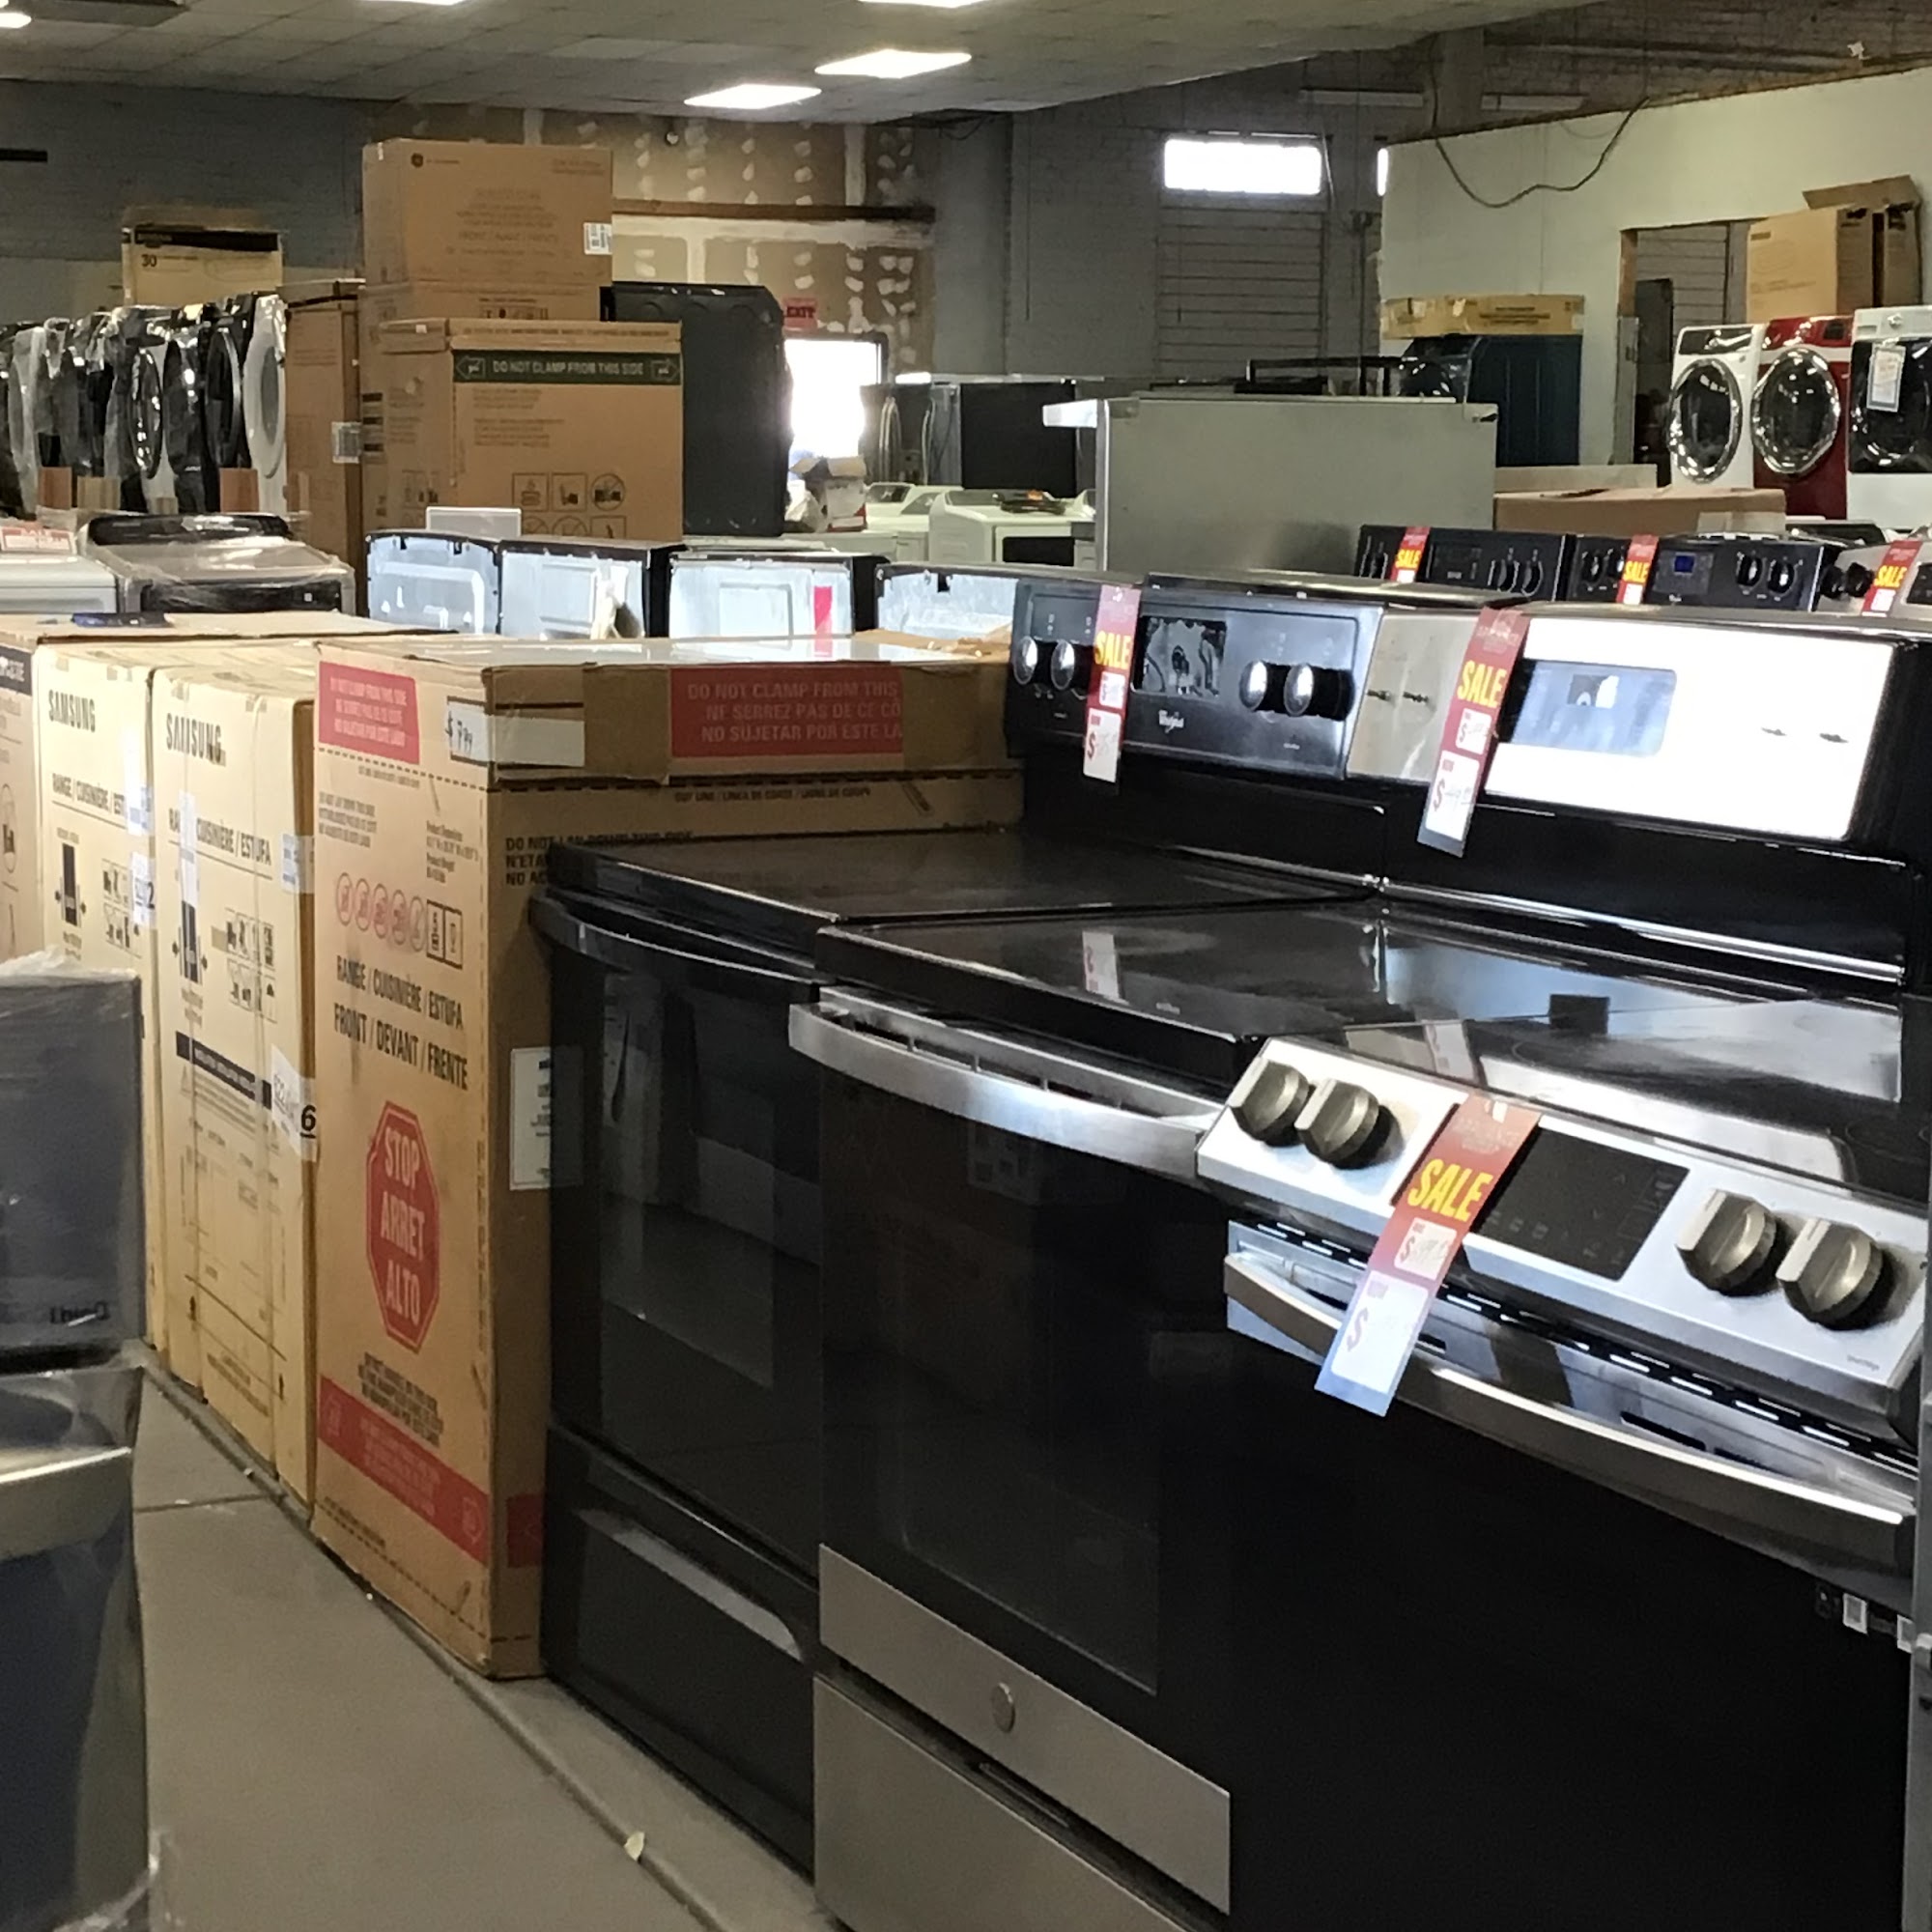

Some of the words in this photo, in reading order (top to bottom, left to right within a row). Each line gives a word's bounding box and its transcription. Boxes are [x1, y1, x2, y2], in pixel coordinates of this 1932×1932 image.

[141, 254, 157, 268] 30
[786, 305, 816, 318] EXIT
[493, 360, 508, 373] DO
[510, 360, 530, 373] NOT
[532, 361, 566, 374] CLAMP
[568, 361, 596, 374] FROM
[598, 362, 619, 374] THIS
[621, 362, 644, 375] SIDE
[1395, 549, 1422, 569] SALE
[1625, 561, 1650, 584] SALE
[1873, 565, 1908, 588] SALE
[1094, 630, 1132, 670] SALE
[687, 683, 711, 699] DO
[715, 683, 748, 699] NOT
[752, 681, 809, 698] CLAMP
[813, 681, 859, 697] FROM
[865, 680, 898, 697] THIS
[1457, 660, 1508, 708] SALE
[48, 689, 97, 733] SAMSUNG
[732, 703, 791, 721] SERREZ
[796, 702, 829, 720] PAS
[832, 702, 853, 719] DE
[166, 713, 223, 764] SAMSUNG
[701, 725, 725, 743] NO
[729, 724, 802, 743] SUJETAR
[807, 724, 838, 741] POR
[841, 724, 881, 740] ESTE
[241, 832, 272, 866] ESTUFA
[505, 837, 525, 851] DO
[506, 872, 526, 885] NO
[337, 954, 366, 991] RANGE
[429, 990, 464, 1031] ESTUFA
[334, 1002, 368, 1044] FRONT
[377, 1019, 419, 1066] DEVANT
[428, 1041, 469, 1091] FRENTE
[384, 1126, 421, 1190] STOP
[1406, 1157, 1494, 1222] SALE
[386, 1259, 421, 1326] ALTO
